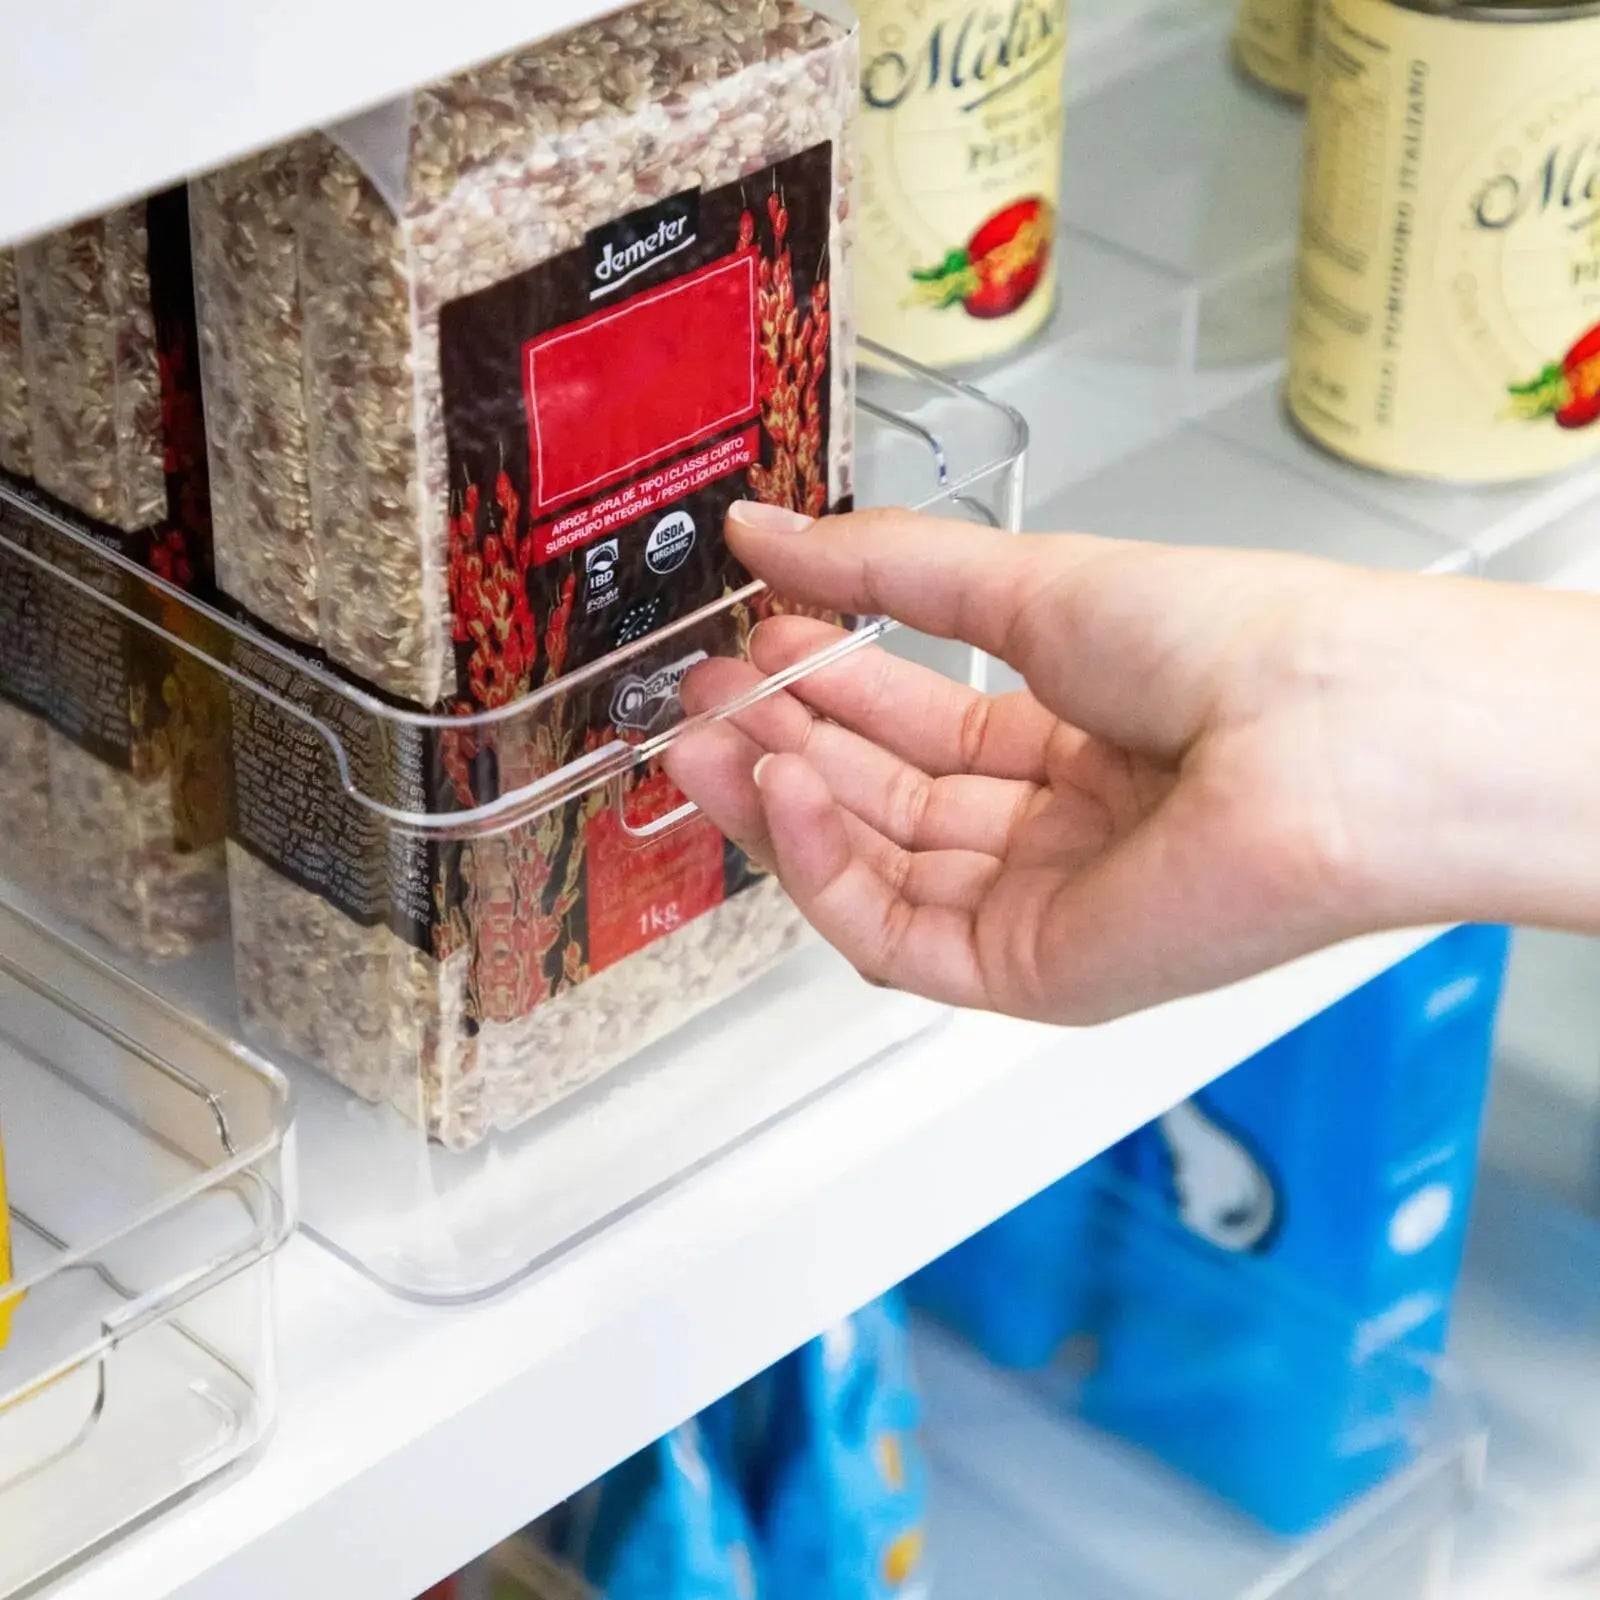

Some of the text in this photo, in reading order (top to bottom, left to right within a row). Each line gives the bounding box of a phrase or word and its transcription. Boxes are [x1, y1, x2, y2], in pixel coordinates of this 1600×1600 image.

[1402, 58, 1430, 193] ITALIANO
[595, 216, 688, 280] demeter
[545, 519, 602, 554] SUBGRUPO
[603, 496, 654, 528] INTEGRAL
[661, 478, 690, 500] PESO
[691, 458, 730, 487] LÍQUIDO
[731, 450, 750, 468] 1Kg
[551, 511, 588, 537] ARROZ
[591, 496, 622, 518] FORA
[622, 489, 636, 505] DE
[639, 474, 664, 496] TIPO
[669, 456, 709, 481] CLASSE
[710, 436, 745, 460] CURTO
[652, 537, 690, 563] ORGANIC
[655, 521, 686, 546] USDA
[590, 569, 615, 589] IBD
[638, 902, 681, 935] 1kg
